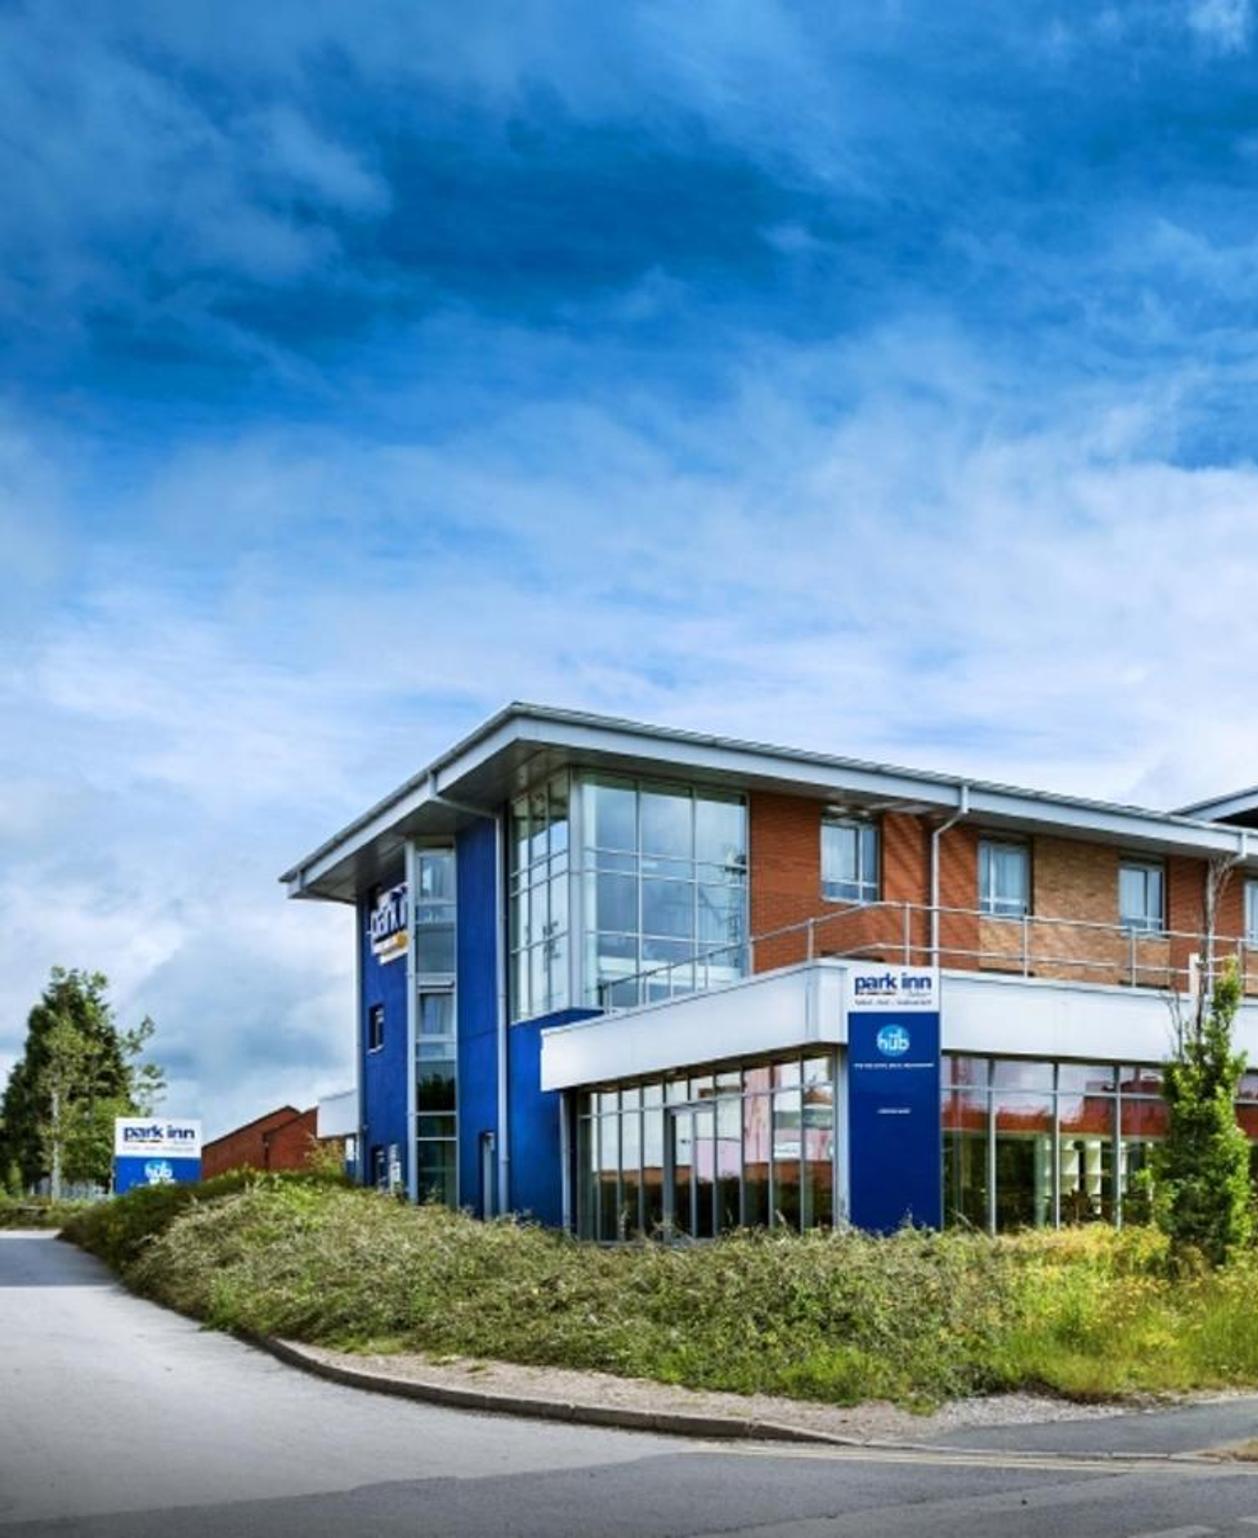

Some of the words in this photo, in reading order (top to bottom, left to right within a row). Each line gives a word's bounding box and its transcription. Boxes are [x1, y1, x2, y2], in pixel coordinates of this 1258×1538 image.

[854, 972, 897, 995] park
[901, 972, 932, 989] inn
[877, 1028, 910, 1050] hub
[123, 1125, 164, 1142] park
[167, 1124, 195, 1139] inn
